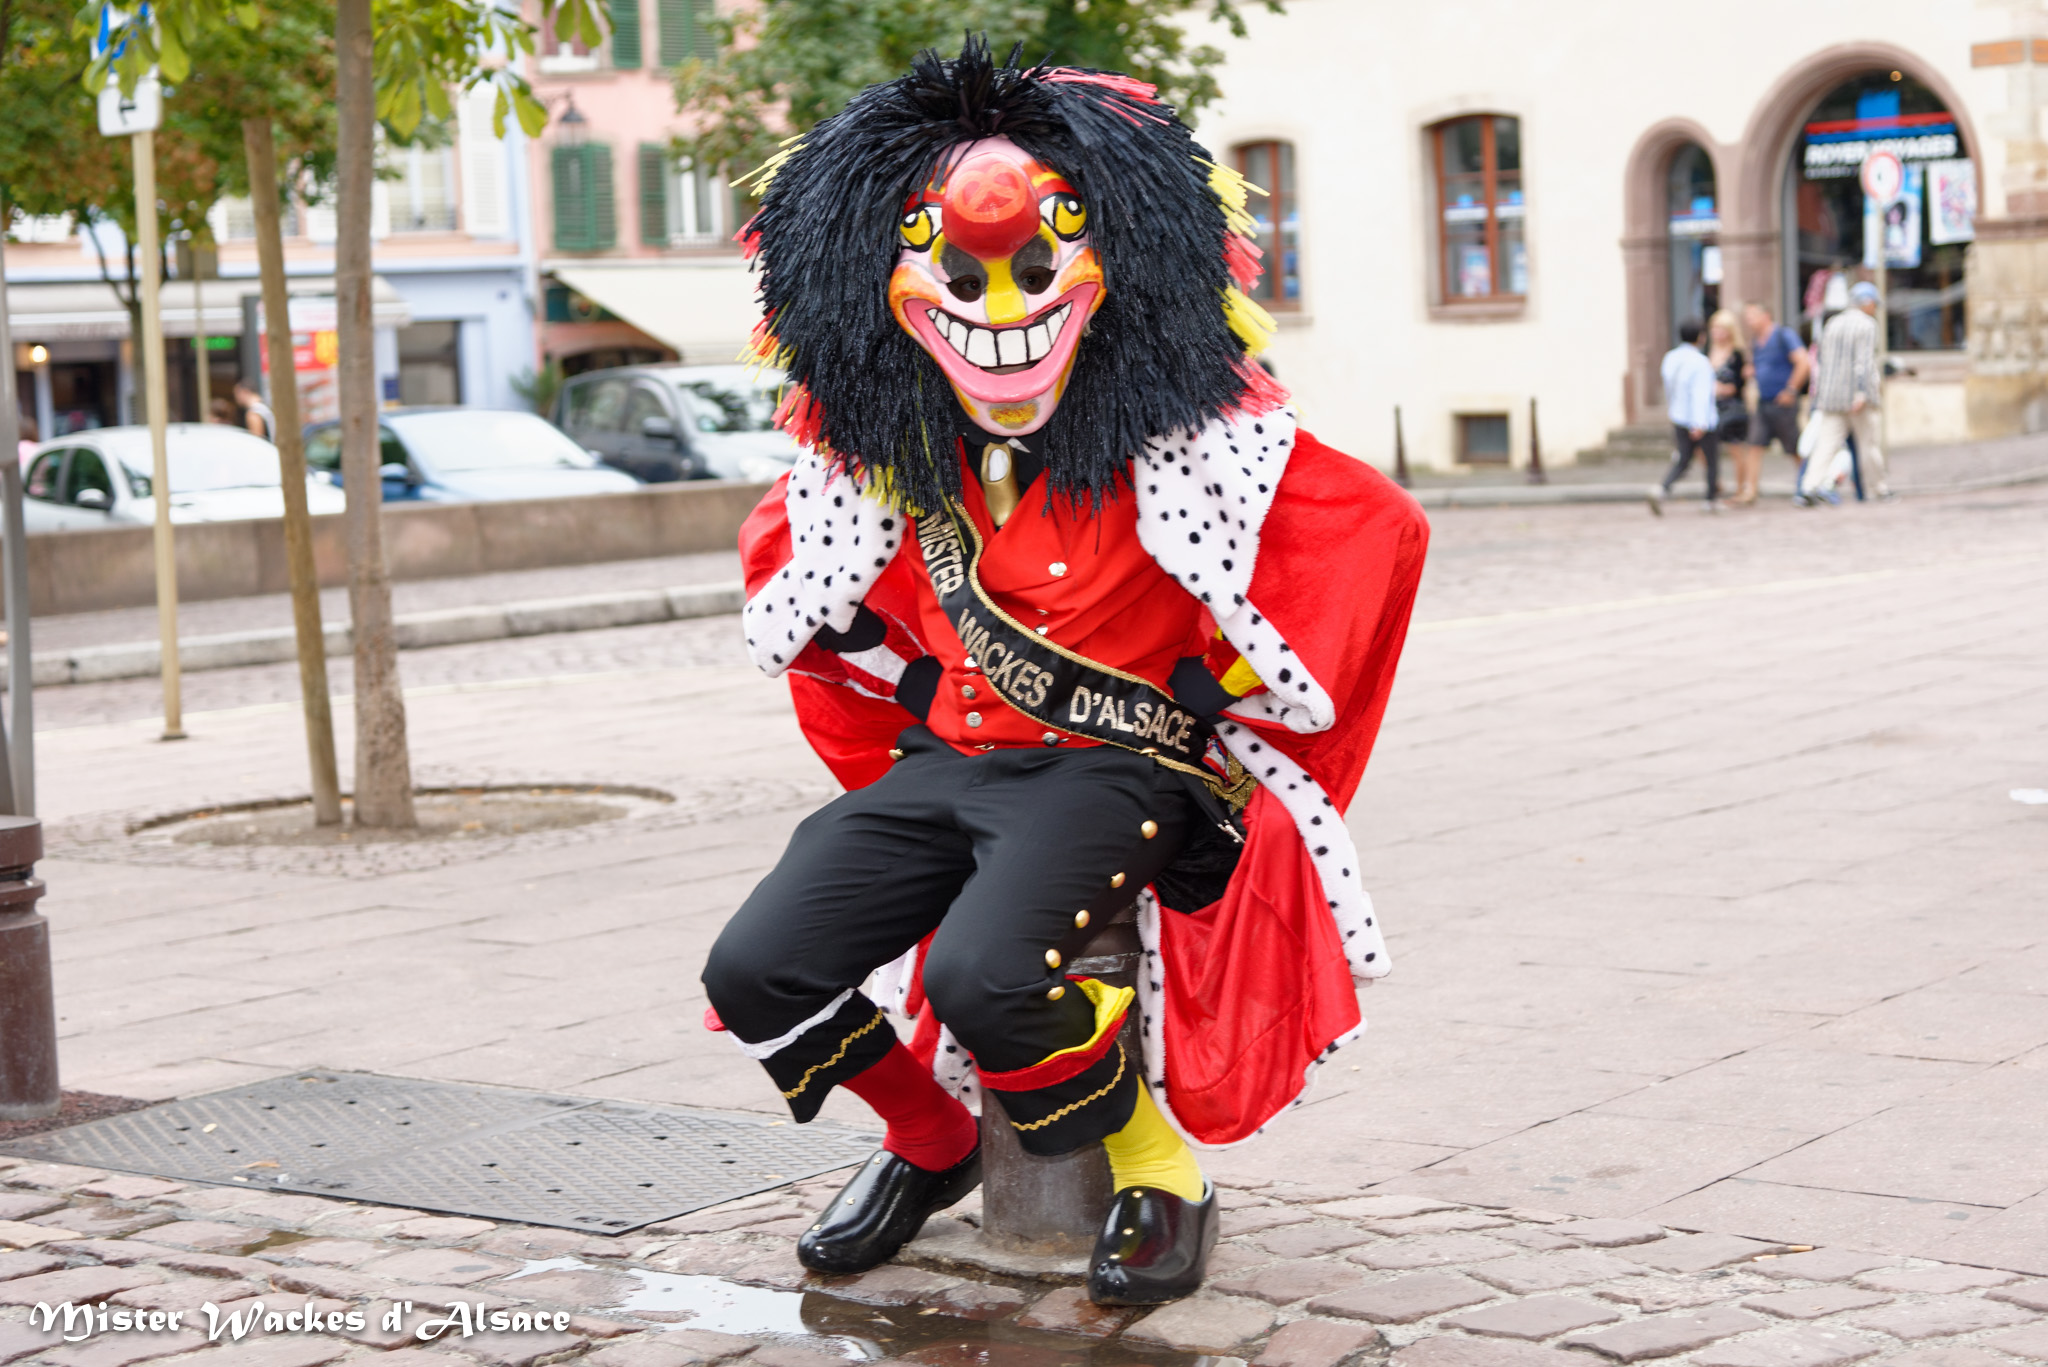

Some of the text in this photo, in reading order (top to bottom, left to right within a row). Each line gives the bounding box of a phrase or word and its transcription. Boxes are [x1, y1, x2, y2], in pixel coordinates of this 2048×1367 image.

[917, 510, 1197, 754] MISTER WACKES D'ALSACE
